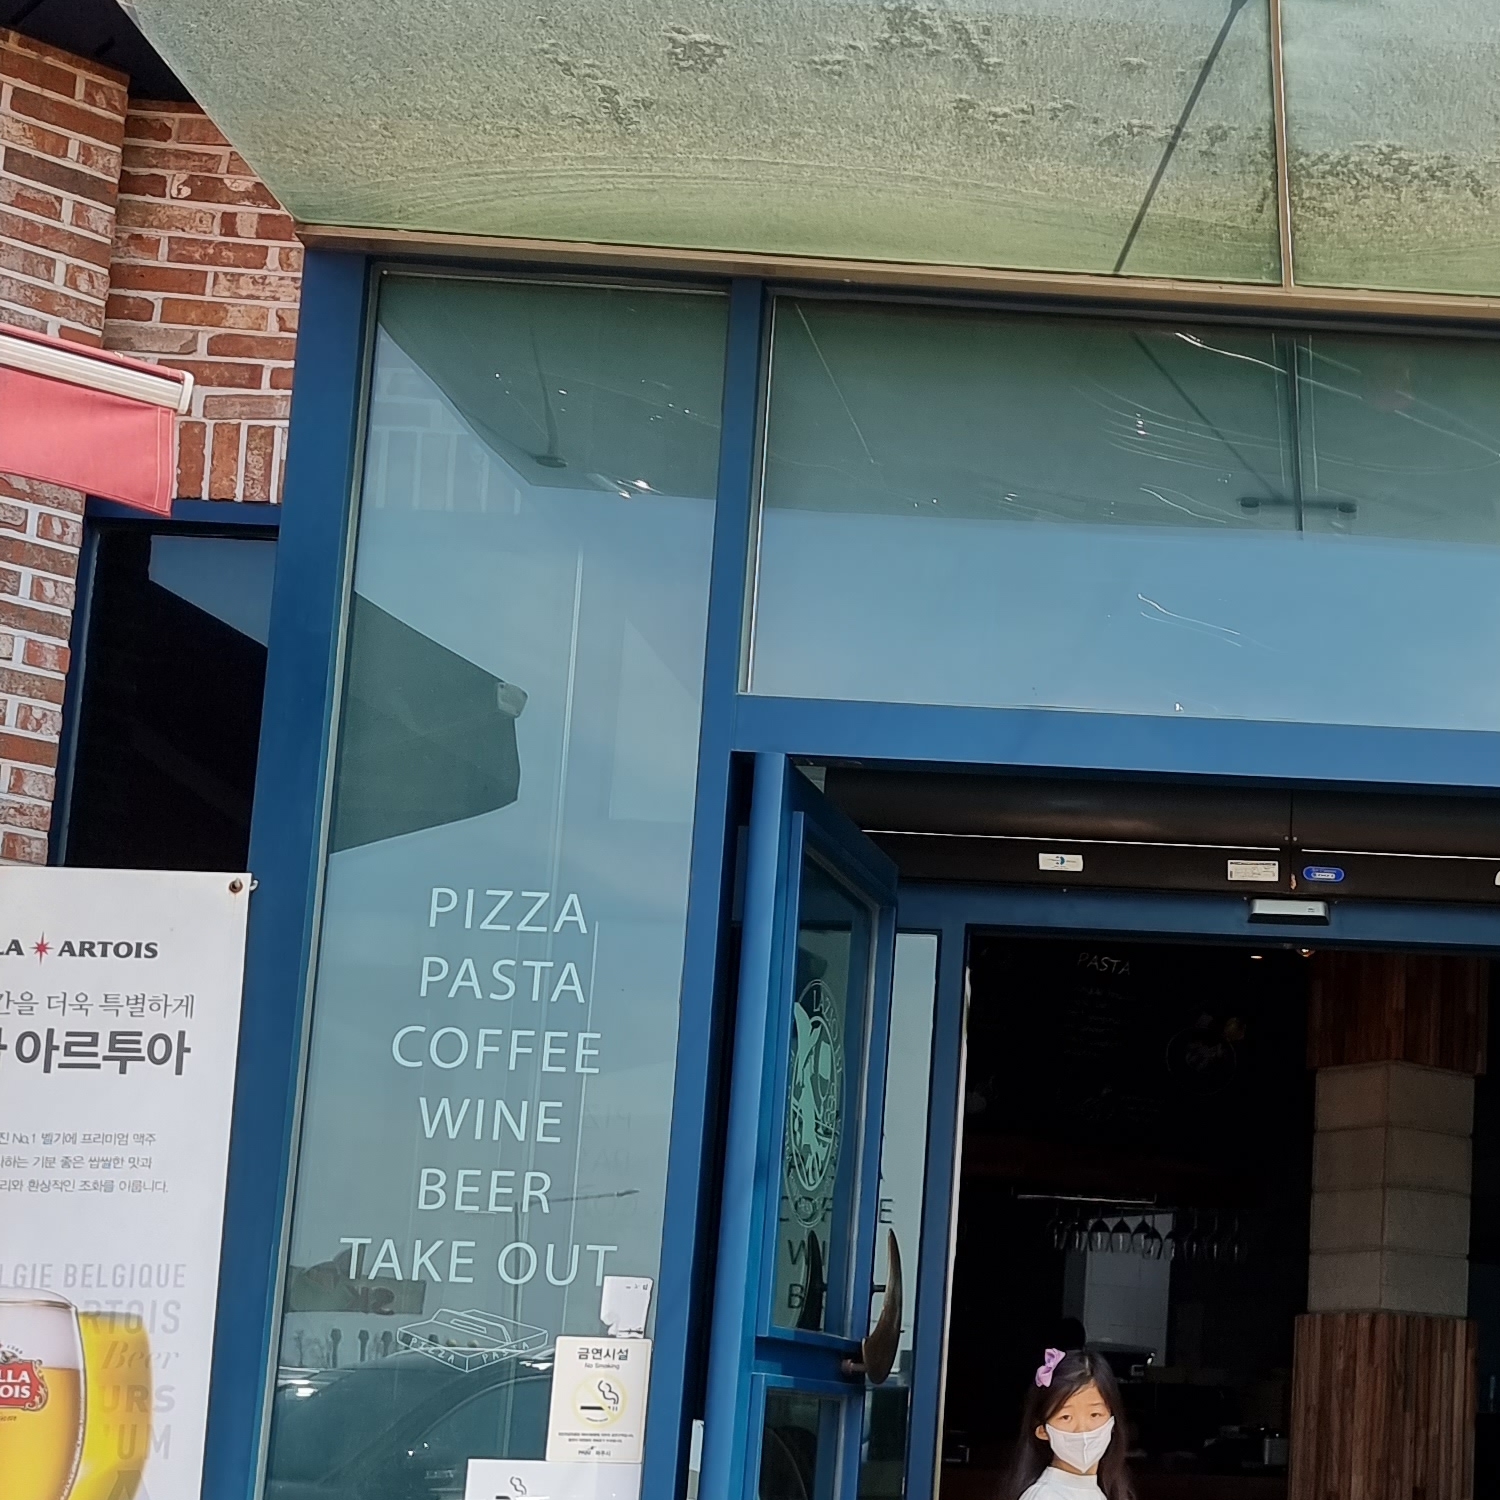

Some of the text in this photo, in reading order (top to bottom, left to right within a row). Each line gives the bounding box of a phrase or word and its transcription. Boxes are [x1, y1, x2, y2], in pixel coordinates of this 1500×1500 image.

[429, 887, 588, 934] PIZZA
[57, 940, 158, 959] ARTOIS
[1077, 952, 1131, 976] PASTA
[419, 956, 585, 1003] PASTA
[47, 991, 94, 1017] 더욱
[99, 993, 195, 1019] 특별하게
[15, 1028, 191, 1075] 아르투아
[391, 1025, 602, 1074] COFFEE
[419, 1097, 563, 1143] WINE
[80, 1132, 129, 1146] 프리미엄
[417, 1168, 552, 1214] BEER
[63, 1264, 187, 1288] BELGIQUE
[339, 1237, 618, 1286] TAKE OUT
[83, 1299, 182, 1335] RTOIS
[103, 1340, 180, 1369] Beer
[577, 1347, 629, 1361] 금연시설
[0, 1384, 31, 1399] OIS
[100, 1384, 175, 1413] URS
